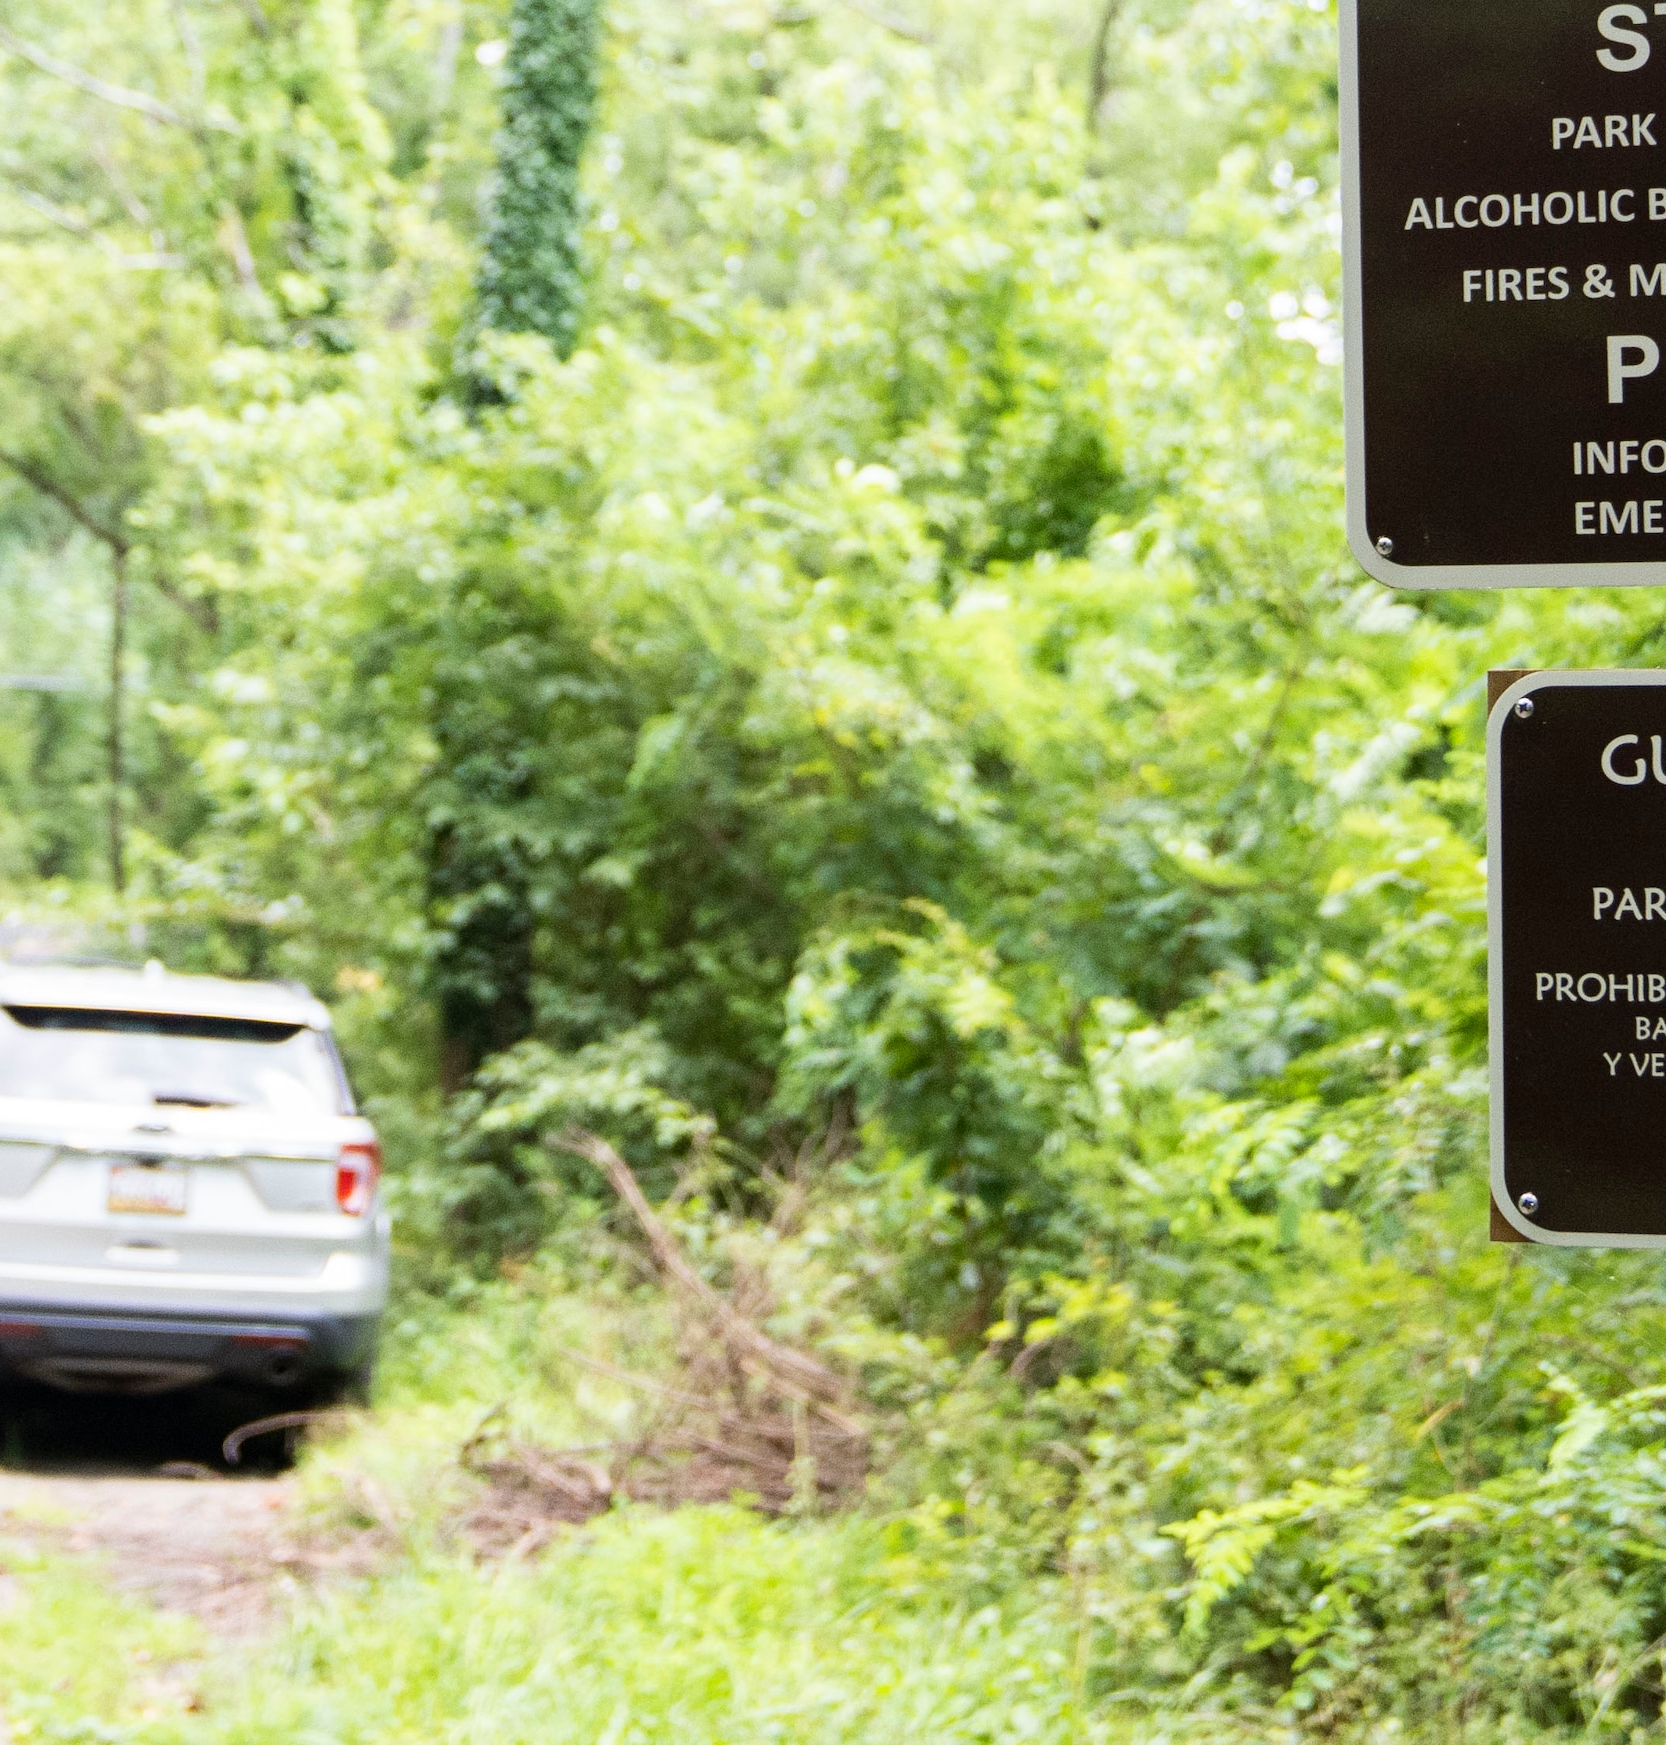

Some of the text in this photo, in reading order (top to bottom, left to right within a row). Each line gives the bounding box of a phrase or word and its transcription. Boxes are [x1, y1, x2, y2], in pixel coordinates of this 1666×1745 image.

[1552, 113, 1657, 150] PARK
[1404, 188, 1635, 231] ALCOHOLIC
[1462, 266, 1570, 303] FIRES
[1582, 263, 1616, 299] &
[1603, 1052, 1622, 1076] Y
